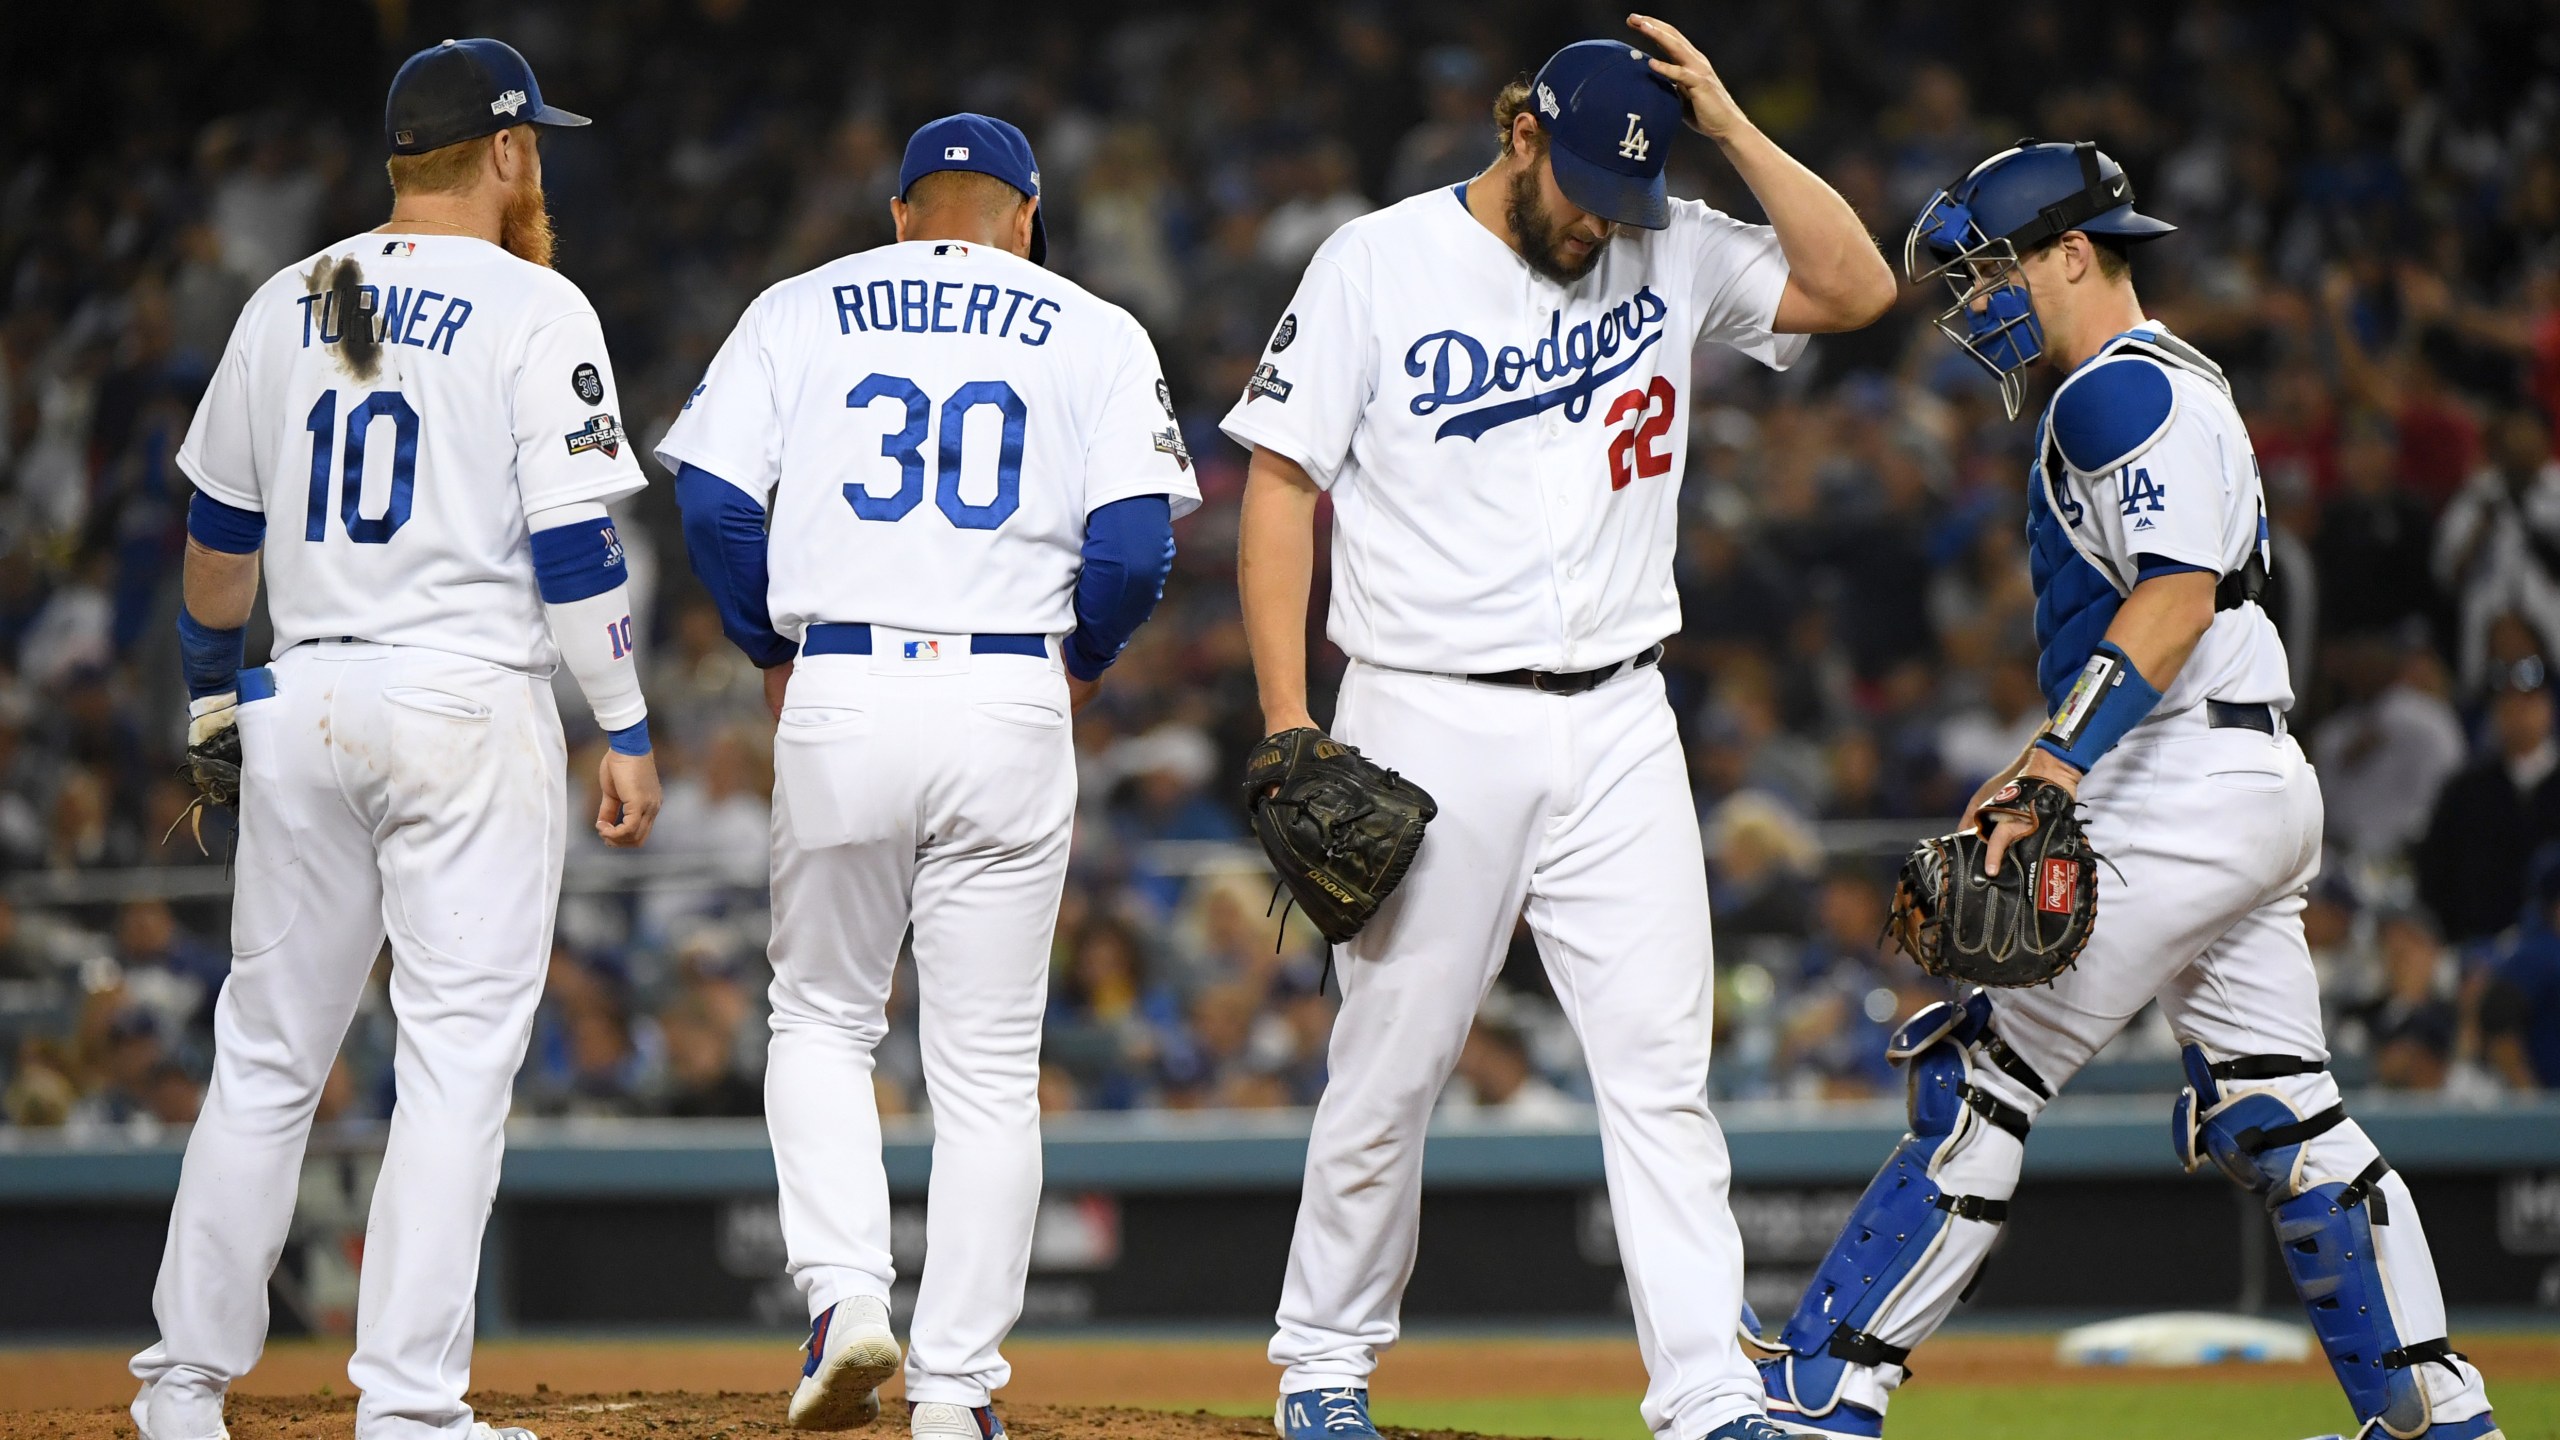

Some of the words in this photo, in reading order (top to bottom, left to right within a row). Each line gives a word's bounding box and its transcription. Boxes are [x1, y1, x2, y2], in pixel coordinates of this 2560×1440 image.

[1619, 112, 1650, 162] LA
[297, 284, 473, 356] TURNER
[832, 279, 1061, 347] ROBERTS
[579, 376, 600, 398] 36
[1404, 285, 1668, 424] Dodgers
[305, 388, 420, 544] 10
[841, 372, 1028, 531] 30
[1603, 375, 1676, 492] 22
[1307, 868, 1355, 904] A2000
[2048, 863, 2066, 908] Rawlings
